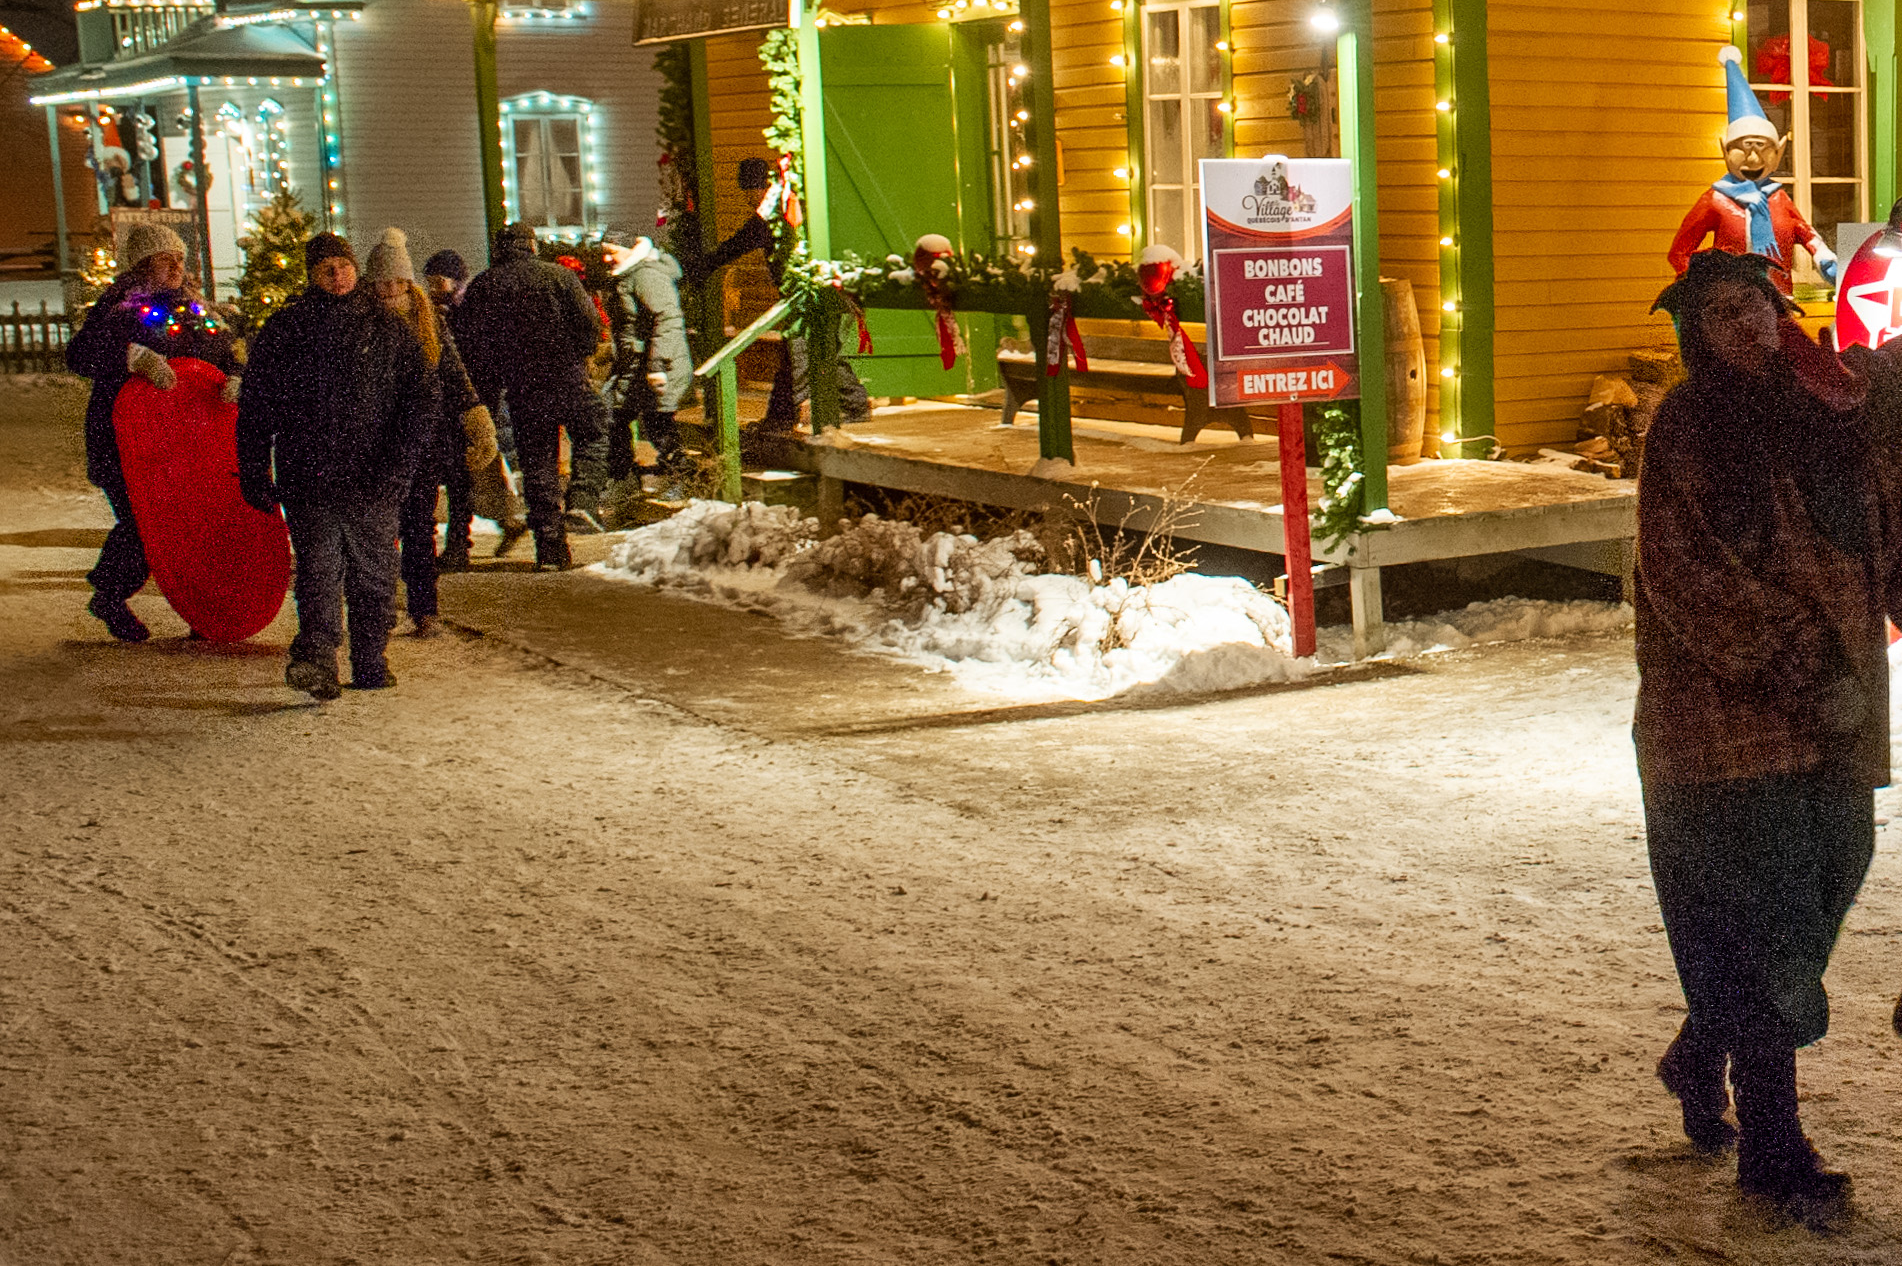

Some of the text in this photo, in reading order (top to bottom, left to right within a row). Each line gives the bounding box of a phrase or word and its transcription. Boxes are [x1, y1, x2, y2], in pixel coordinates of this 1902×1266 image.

[1242, 195, 1293, 221] Village
[1244, 258, 1323, 278] BONBONS
[1265, 280, 1305, 304] CAFÉ
[1242, 306, 1329, 328] CHOCOLAT
[1258, 325, 1316, 346] CHAUD
[1243, 369, 1335, 394] ENTREZ ICI
